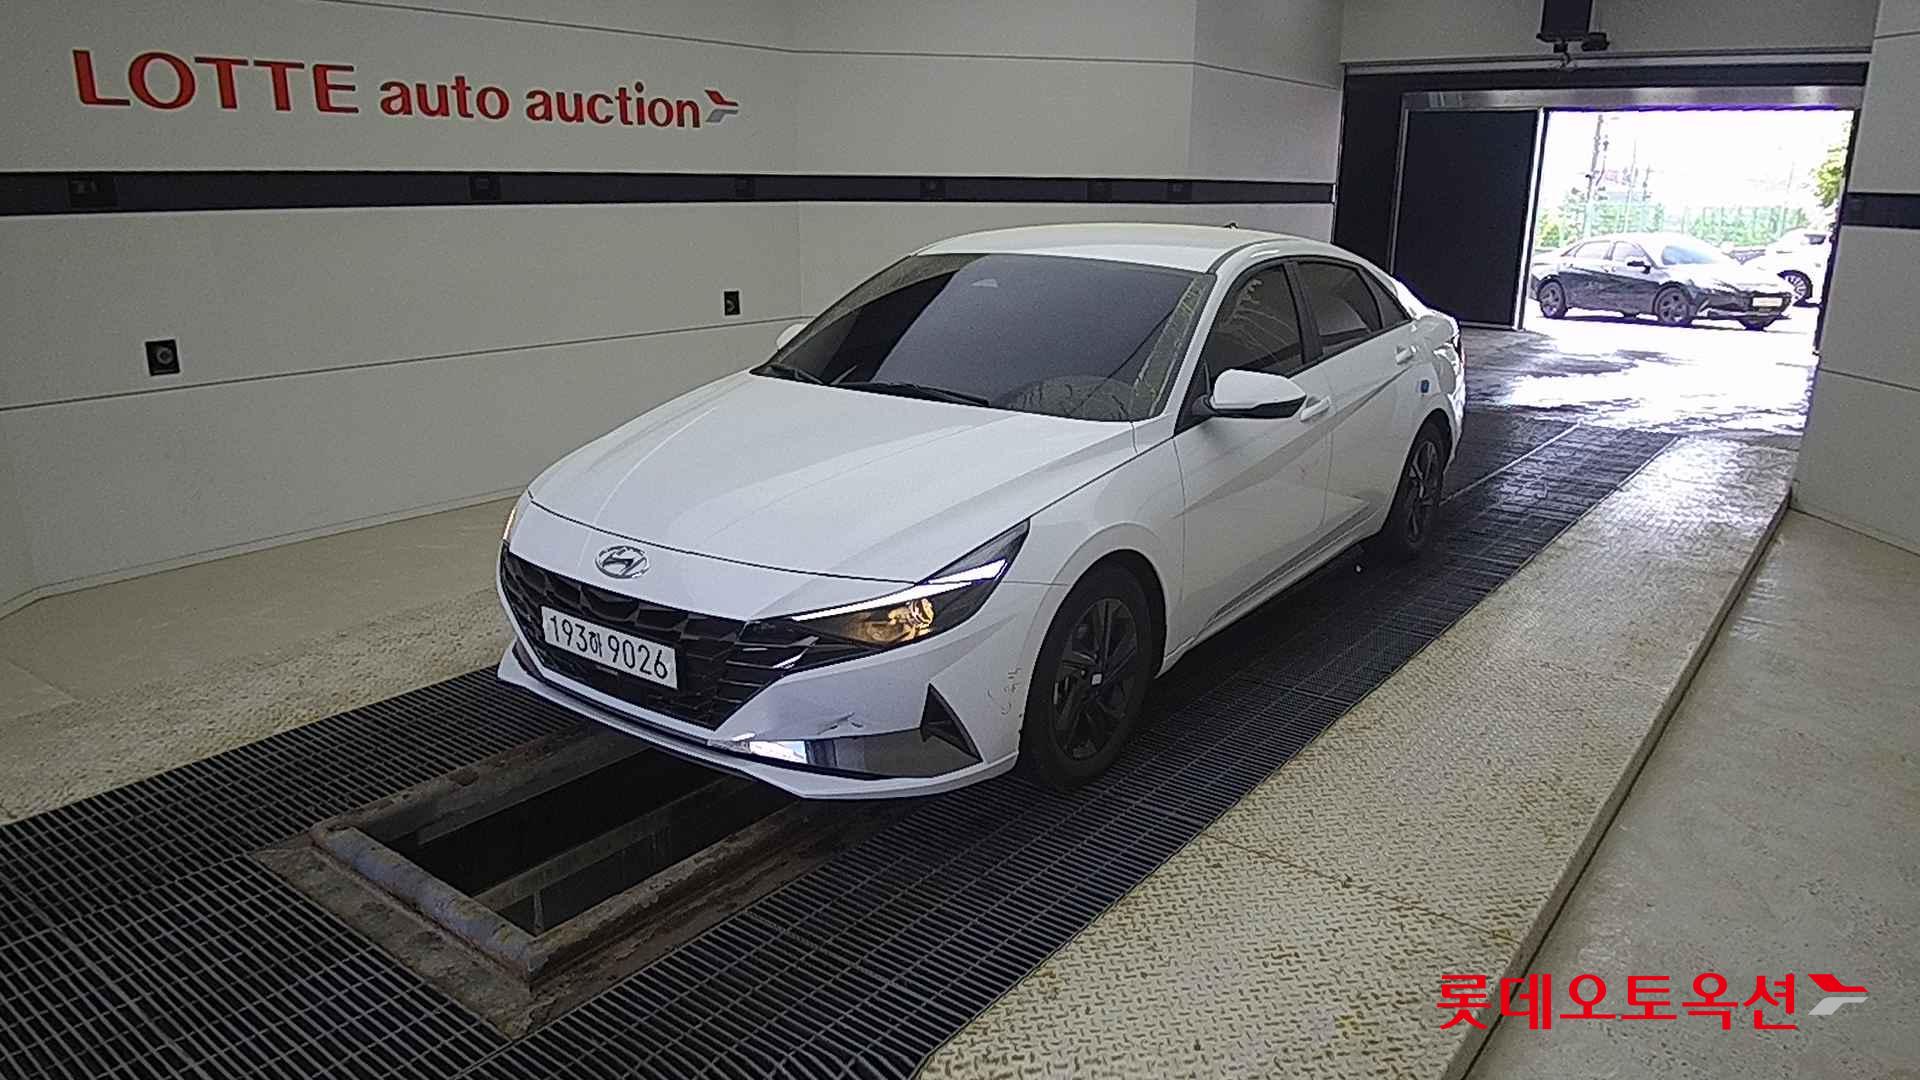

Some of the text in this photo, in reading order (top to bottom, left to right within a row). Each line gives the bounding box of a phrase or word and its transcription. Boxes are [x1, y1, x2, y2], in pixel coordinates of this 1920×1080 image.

[73, 50, 701, 128] LOTTE auto auction
